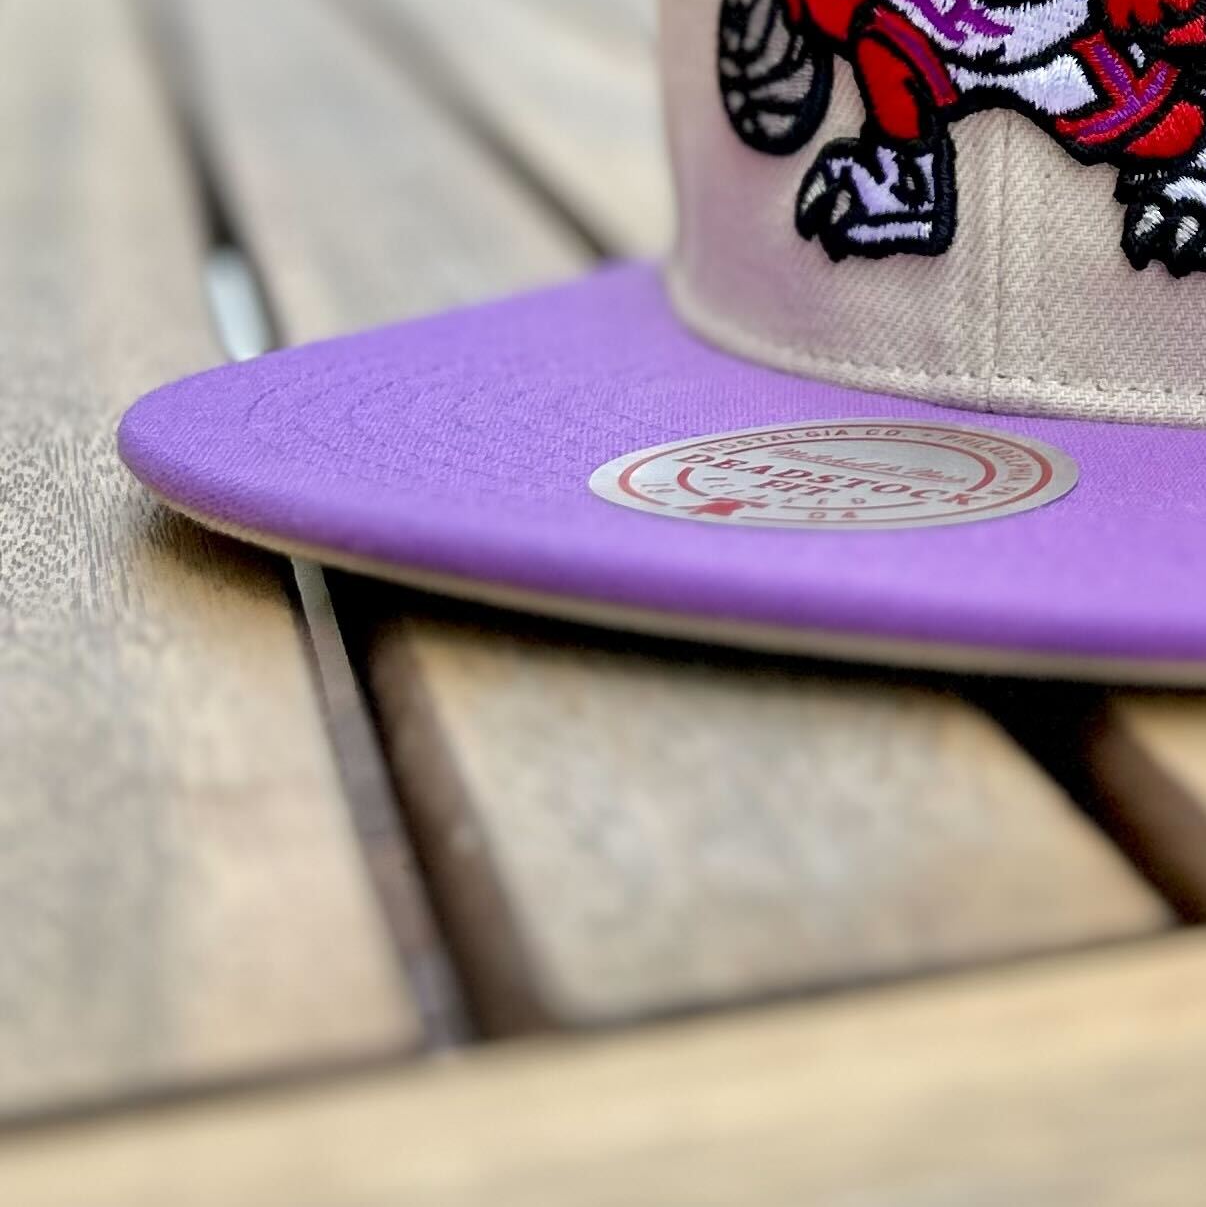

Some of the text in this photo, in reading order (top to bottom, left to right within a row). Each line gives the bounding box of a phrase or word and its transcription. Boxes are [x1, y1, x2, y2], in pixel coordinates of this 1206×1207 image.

[698, 430, 848, 453] NOSTALGIA
[673, 453, 987, 506] DEADSTOCK
[751, 479, 840, 496] FIT
